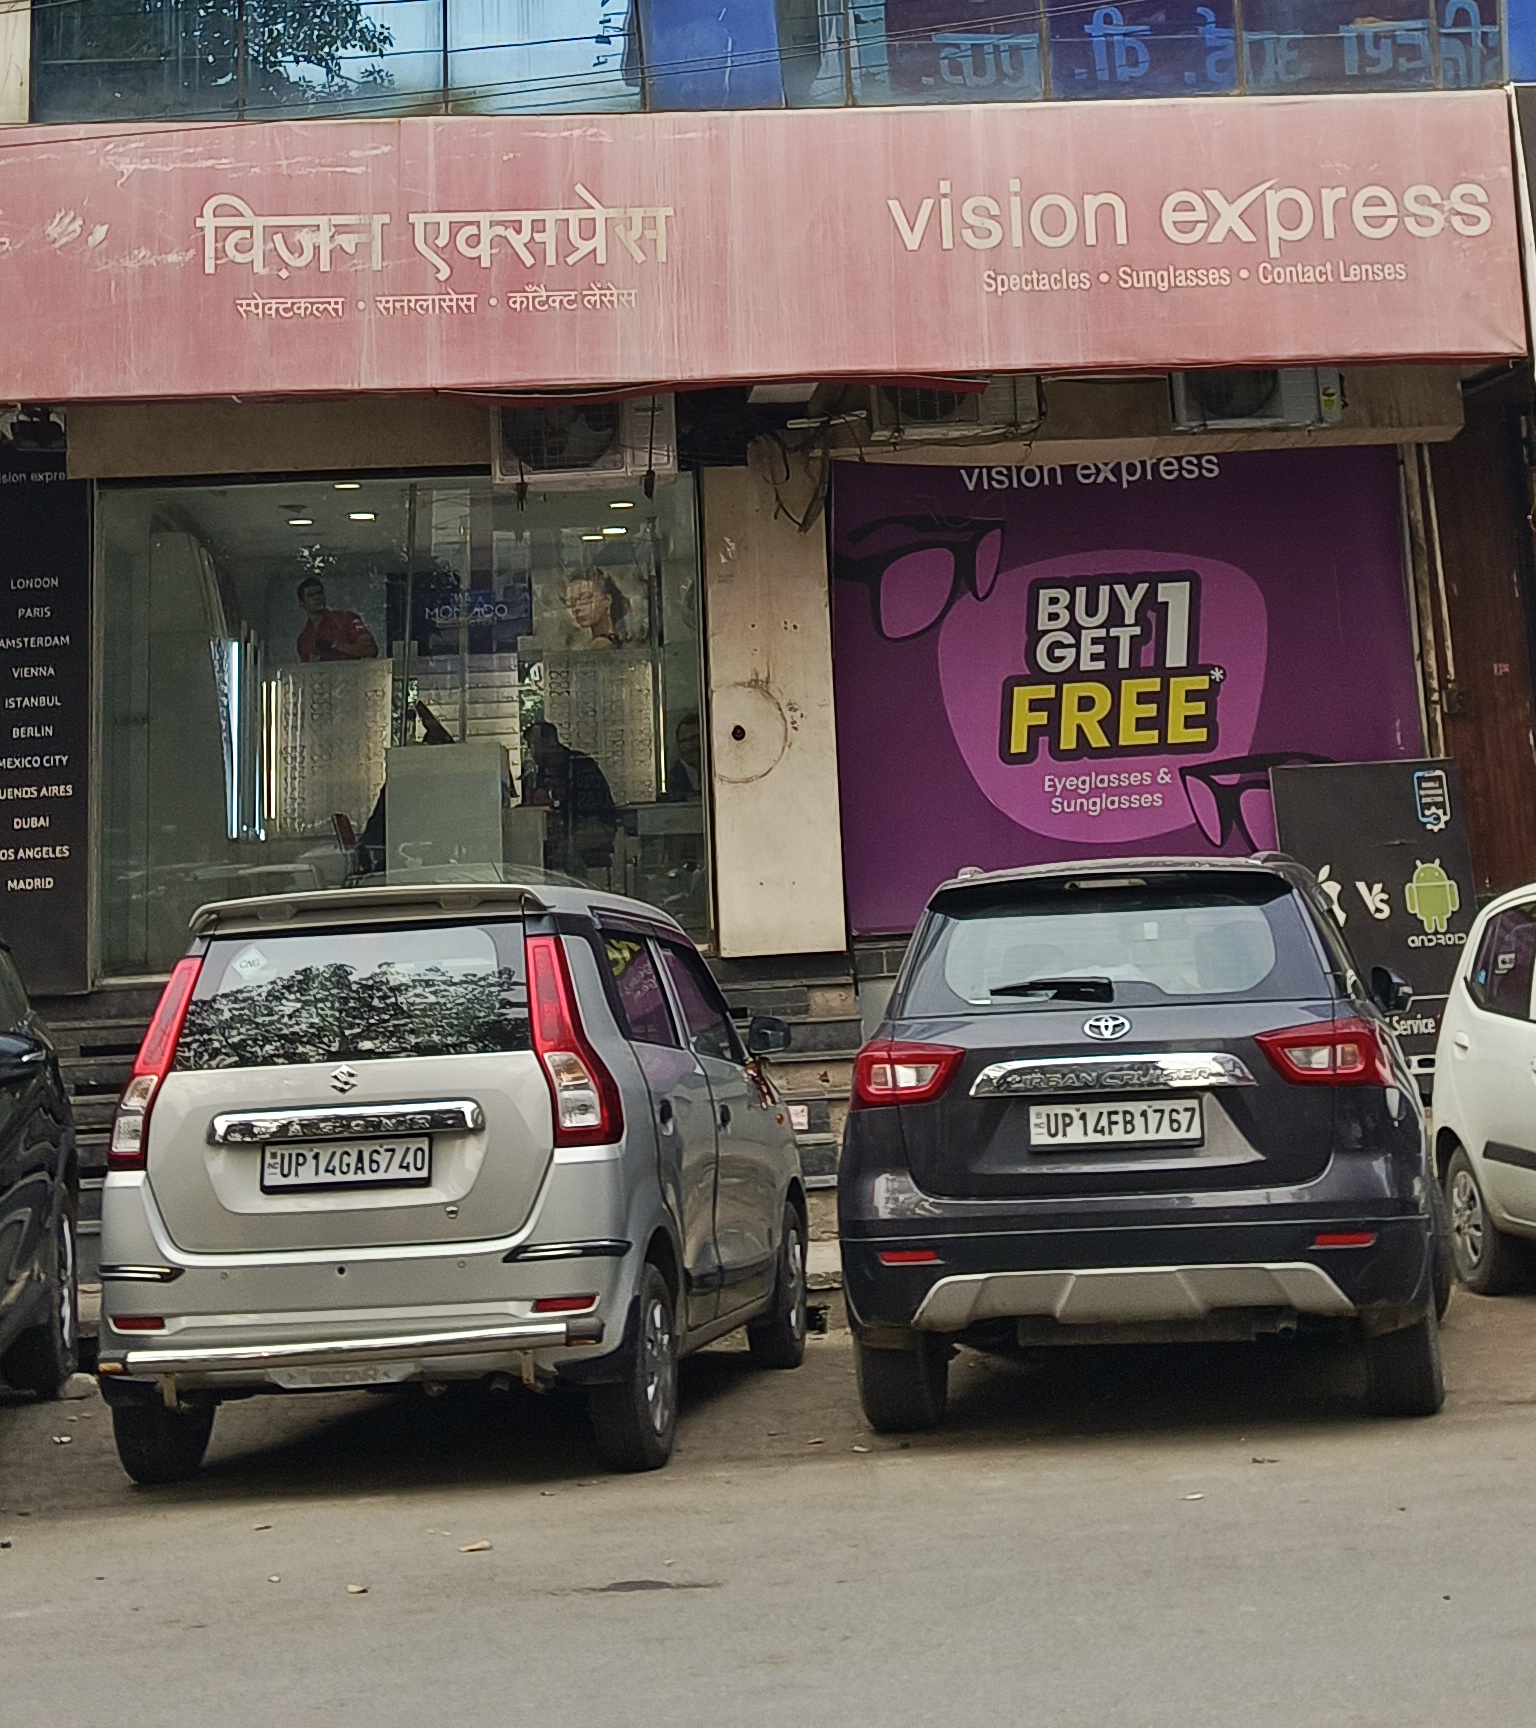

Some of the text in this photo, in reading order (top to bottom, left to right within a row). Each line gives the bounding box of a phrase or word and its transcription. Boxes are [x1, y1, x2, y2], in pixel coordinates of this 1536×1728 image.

[887, 176, 1493, 259] vision express
[981, 259, 1408, 295] Spectacles Sunglasses Contact Lenses
[1075, 453, 1221, 489] express
[10, 576, 60, 590] LONDON
[17, 606, 52, 620] PARIS
[1036, 580, 1191, 669] BUY 1
[1035, 625, 1142, 673] GET
[11, 665, 56, 679] VIENNA
[4, 695, 62, 709] ISTANBUL
[12, 725, 53, 739] BERLIN
[43, 754, 69, 768] CITY
[1043, 768, 1173, 796] Eyeglasses &
[40, 784, 73, 798] AIRES
[1050, 789, 1164, 816] Sunglasses
[13, 816, 50, 830] DUBAI
[17, 845, 71, 860] ANGELES
[7, 877, 54, 891] MADRID
[1045, 1106, 1197, 1139] UP14FB1767
[279, 1146, 426, 1180] UP14GA6740
